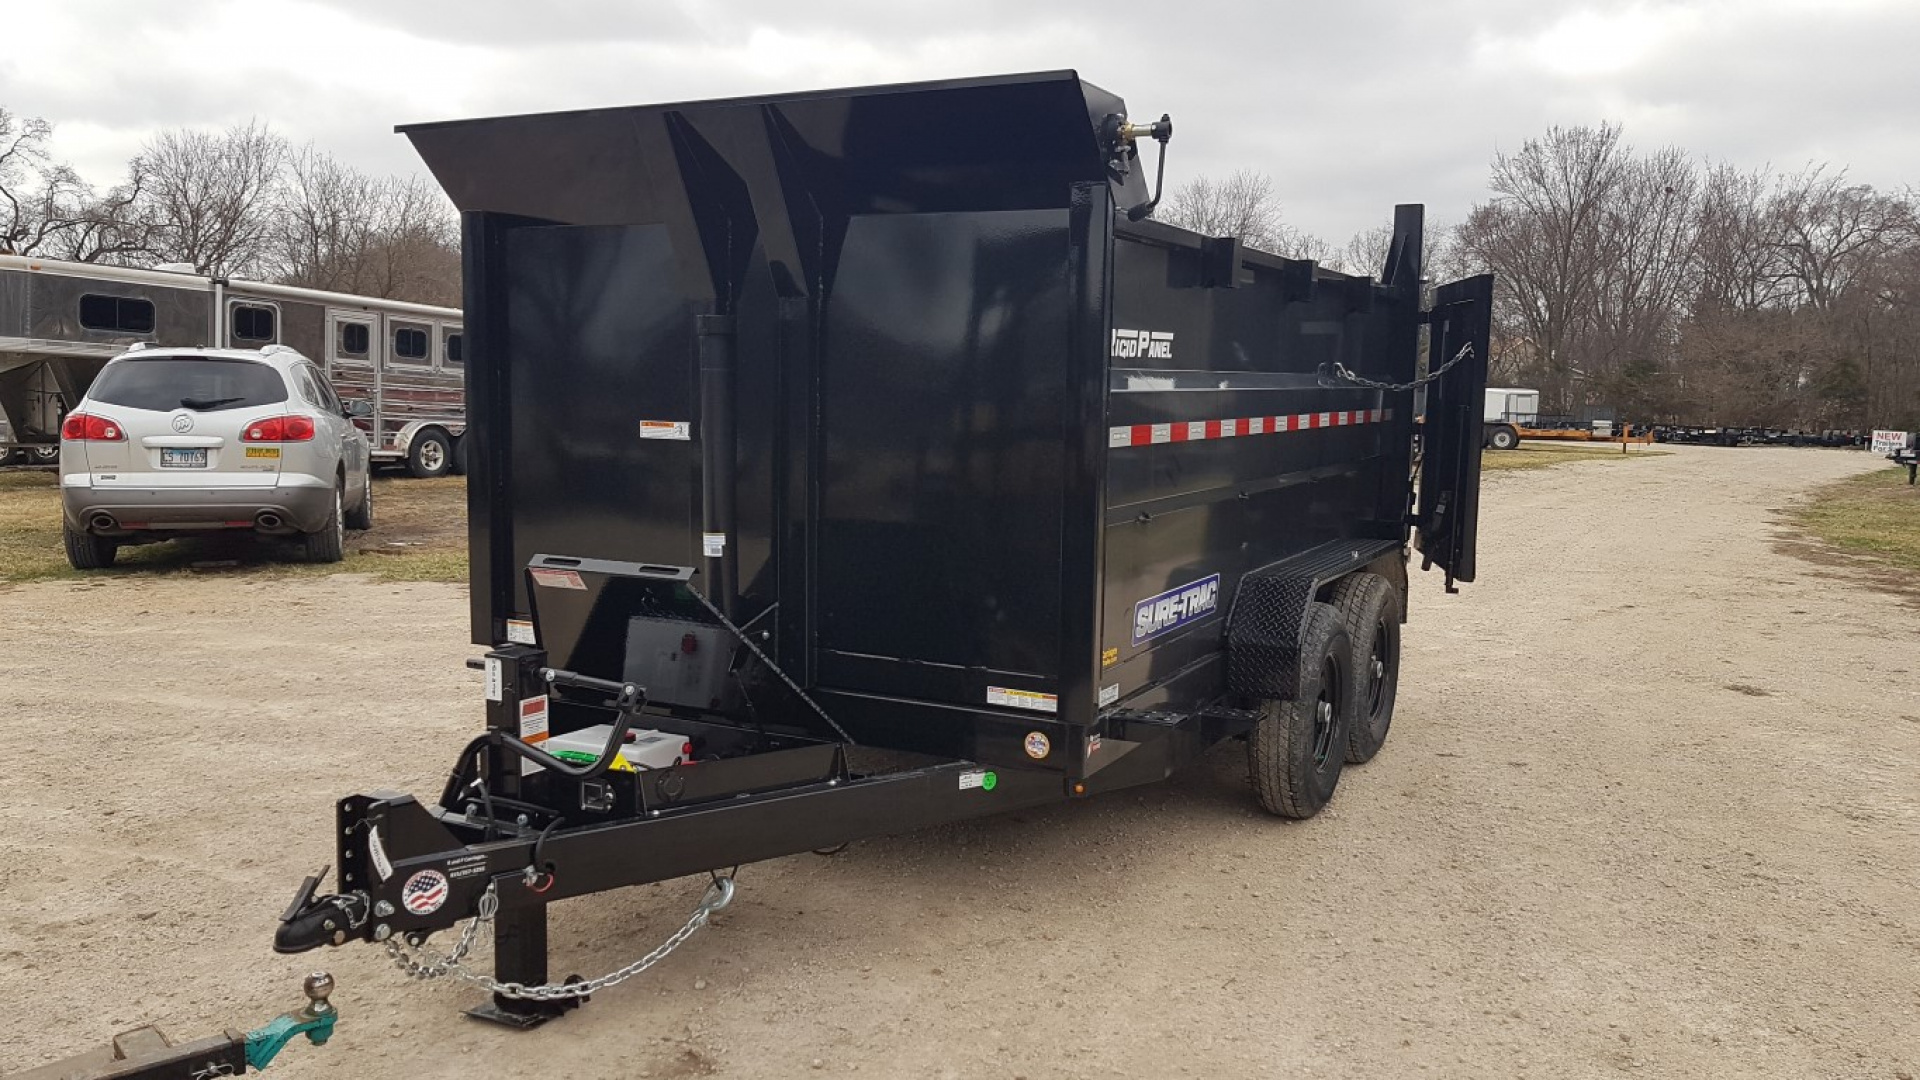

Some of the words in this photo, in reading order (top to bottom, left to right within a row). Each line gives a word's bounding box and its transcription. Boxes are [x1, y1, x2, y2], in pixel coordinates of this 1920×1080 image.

[1138, 330, 1174, 358] PANEL
[1877, 432, 1902, 440] NEW
[1135, 580, 1218, 639] SURE-TRAC
